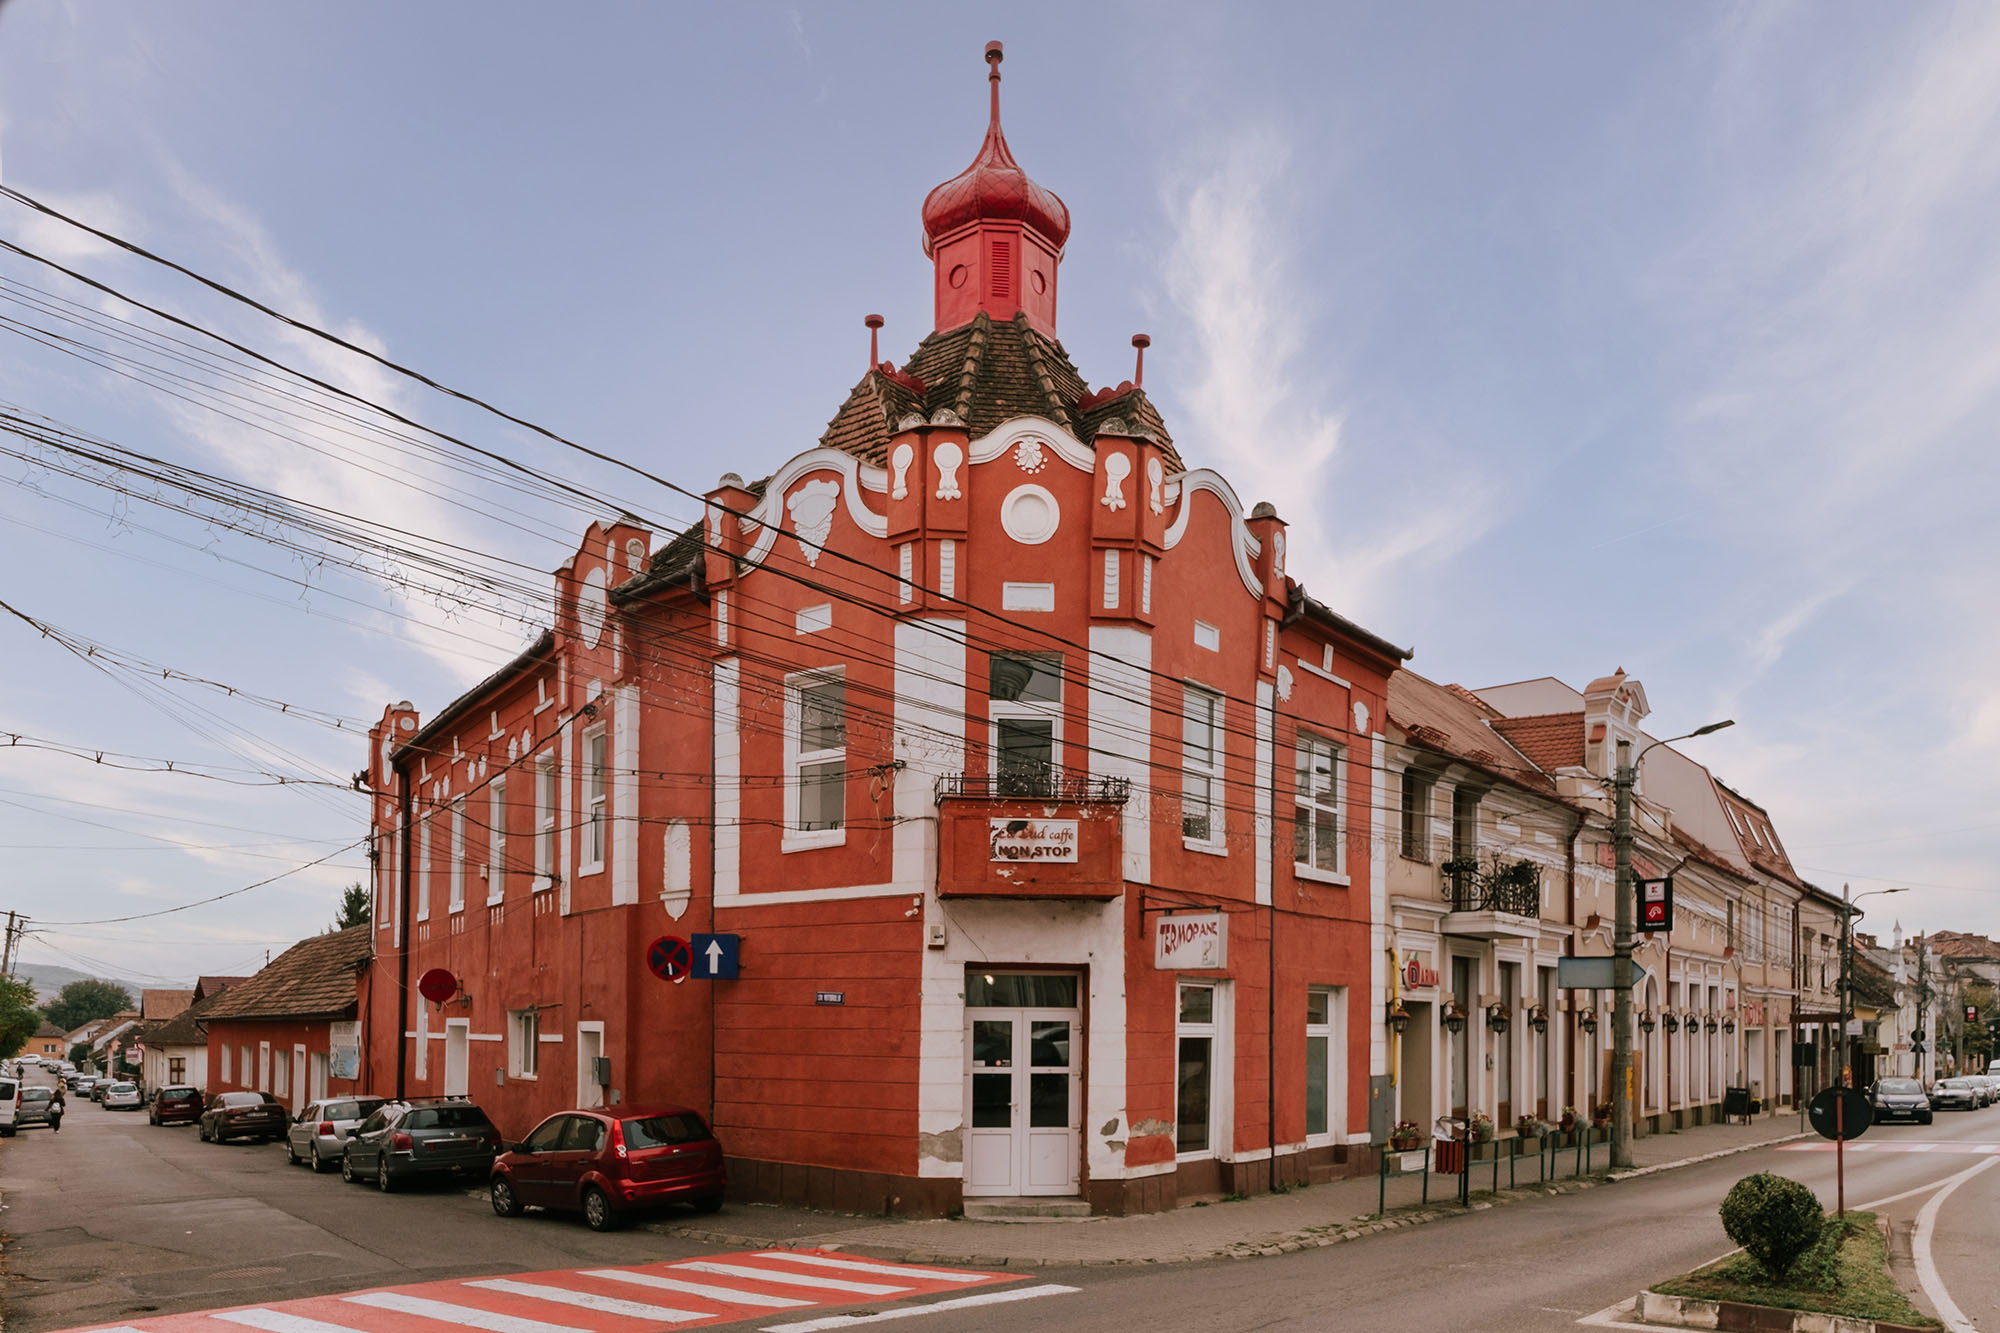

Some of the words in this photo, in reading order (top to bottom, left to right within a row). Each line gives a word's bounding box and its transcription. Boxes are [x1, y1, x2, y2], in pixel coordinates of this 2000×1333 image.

[1049, 828, 1073, 844] caffe
[999, 846, 1030, 857] NON
[1035, 846, 1071, 857] STOP
[1160, 922, 1217, 959] TERMOPANE
